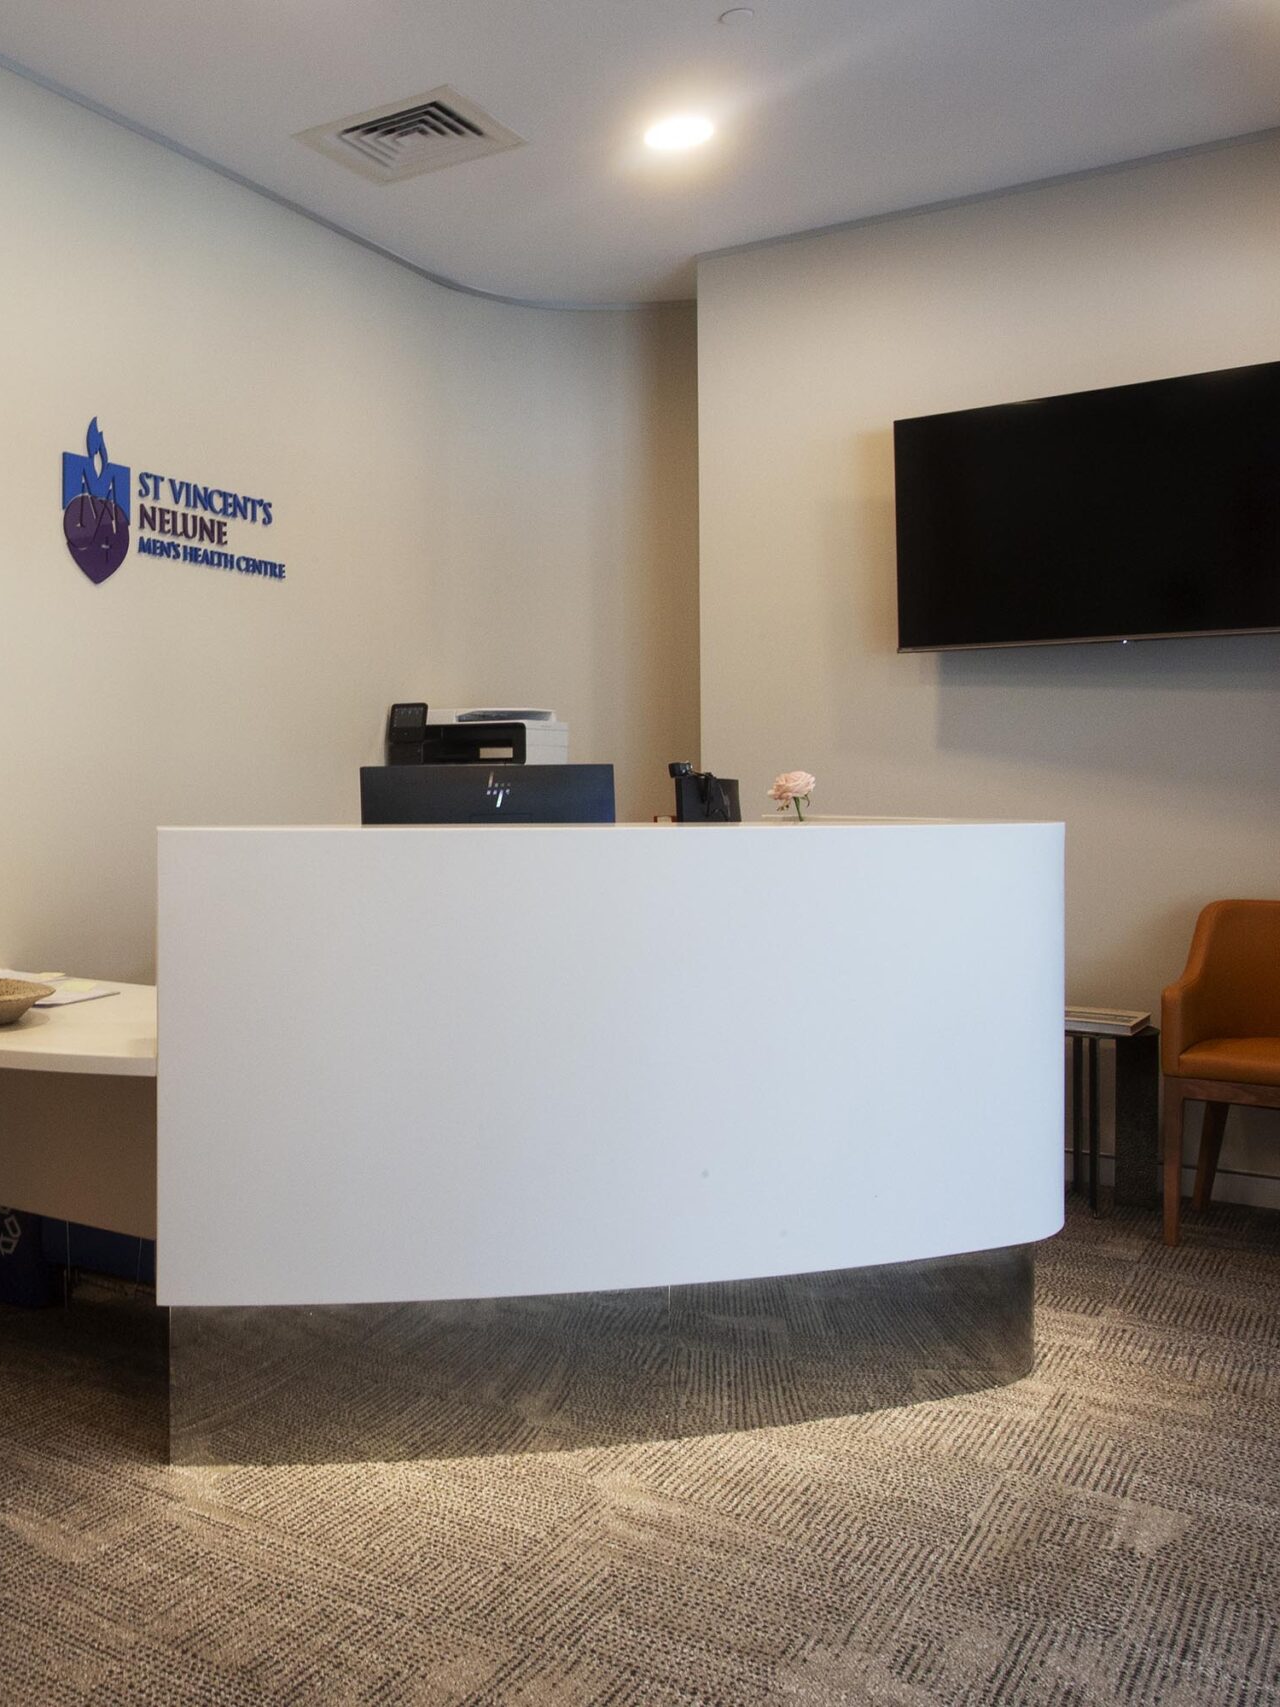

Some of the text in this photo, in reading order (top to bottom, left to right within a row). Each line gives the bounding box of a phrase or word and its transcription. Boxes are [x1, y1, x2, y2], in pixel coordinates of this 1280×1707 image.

[138, 472, 273, 526] ST VINCENT'S
[138, 503, 228, 545] NELUNE
[138, 536, 286, 580] MEN'S HEALTH CENTRE
